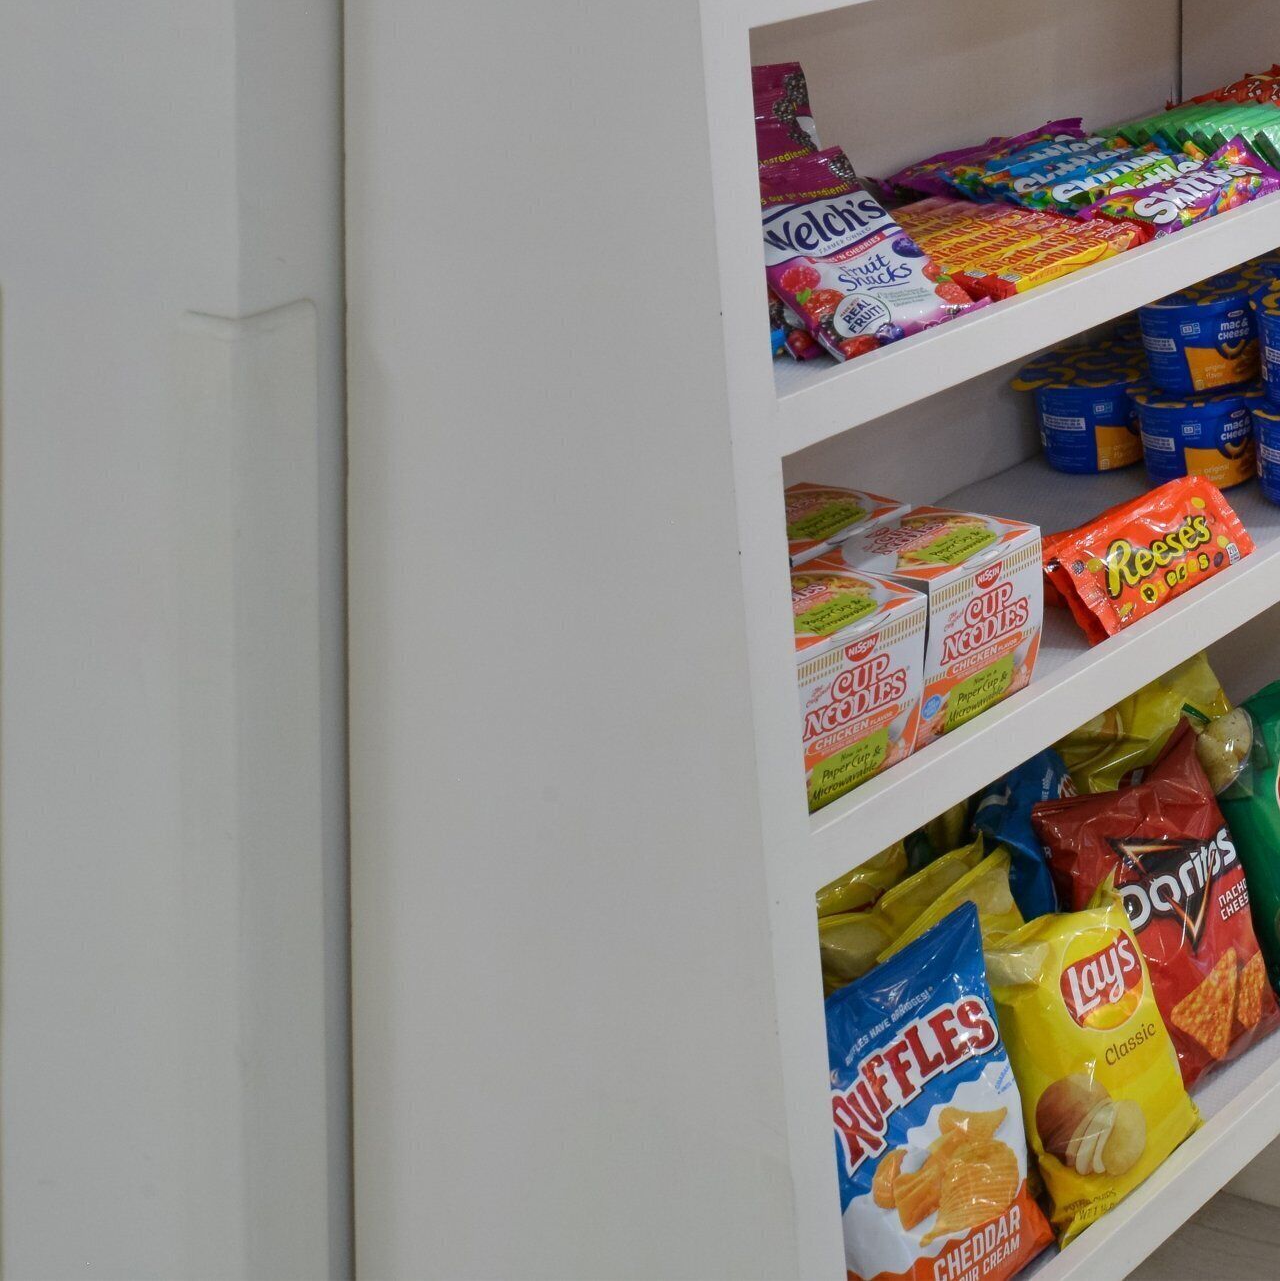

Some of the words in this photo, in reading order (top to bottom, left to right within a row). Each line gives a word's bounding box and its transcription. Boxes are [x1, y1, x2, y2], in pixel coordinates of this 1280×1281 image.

[763, 199, 887, 252] Welch's
[845, 226, 872, 244] OWNED
[838, 253, 891, 277] Fruit
[838, 263, 912, 292] Snacks
[842, 298, 872, 327] REAL
[848, 306, 885, 334] FRUIT!
[976, 566, 1001, 584] NISSIN
[964, 581, 1014, 626] CUP
[848, 636, 877, 658] NISSIN
[940, 596, 1030, 667] NOODLES
[831, 653, 890, 701] CUP
[951, 644, 999, 676] CHICKEN
[998, 637, 1018, 651] FLAVOR
[803, 667, 907, 743] NOODLES
[948, 686, 1005, 722] Microwavable
[957, 683, 982, 704] Paper
[981, 677, 1000, 694] Cup
[1000, 671, 1008, 682] &
[815, 718, 870, 751] CHICKEN
[869, 709, 894, 726] FLAVOR
[811, 760, 878, 802] Microwavable
[821, 761, 851, 784] Paper
[851, 752, 871, 769] Cup
[873, 744, 883, 756] &
[1120, 826, 1237, 930] Doritos
[1218, 878, 1248, 908] NACHO
[1067, 936, 1136, 1019] Lay's
[1104, 1021, 1156, 1067] Classic
[832, 1000, 996, 1168] RUFFLES
[932, 1205, 1021, 1281] CHEDDAR
